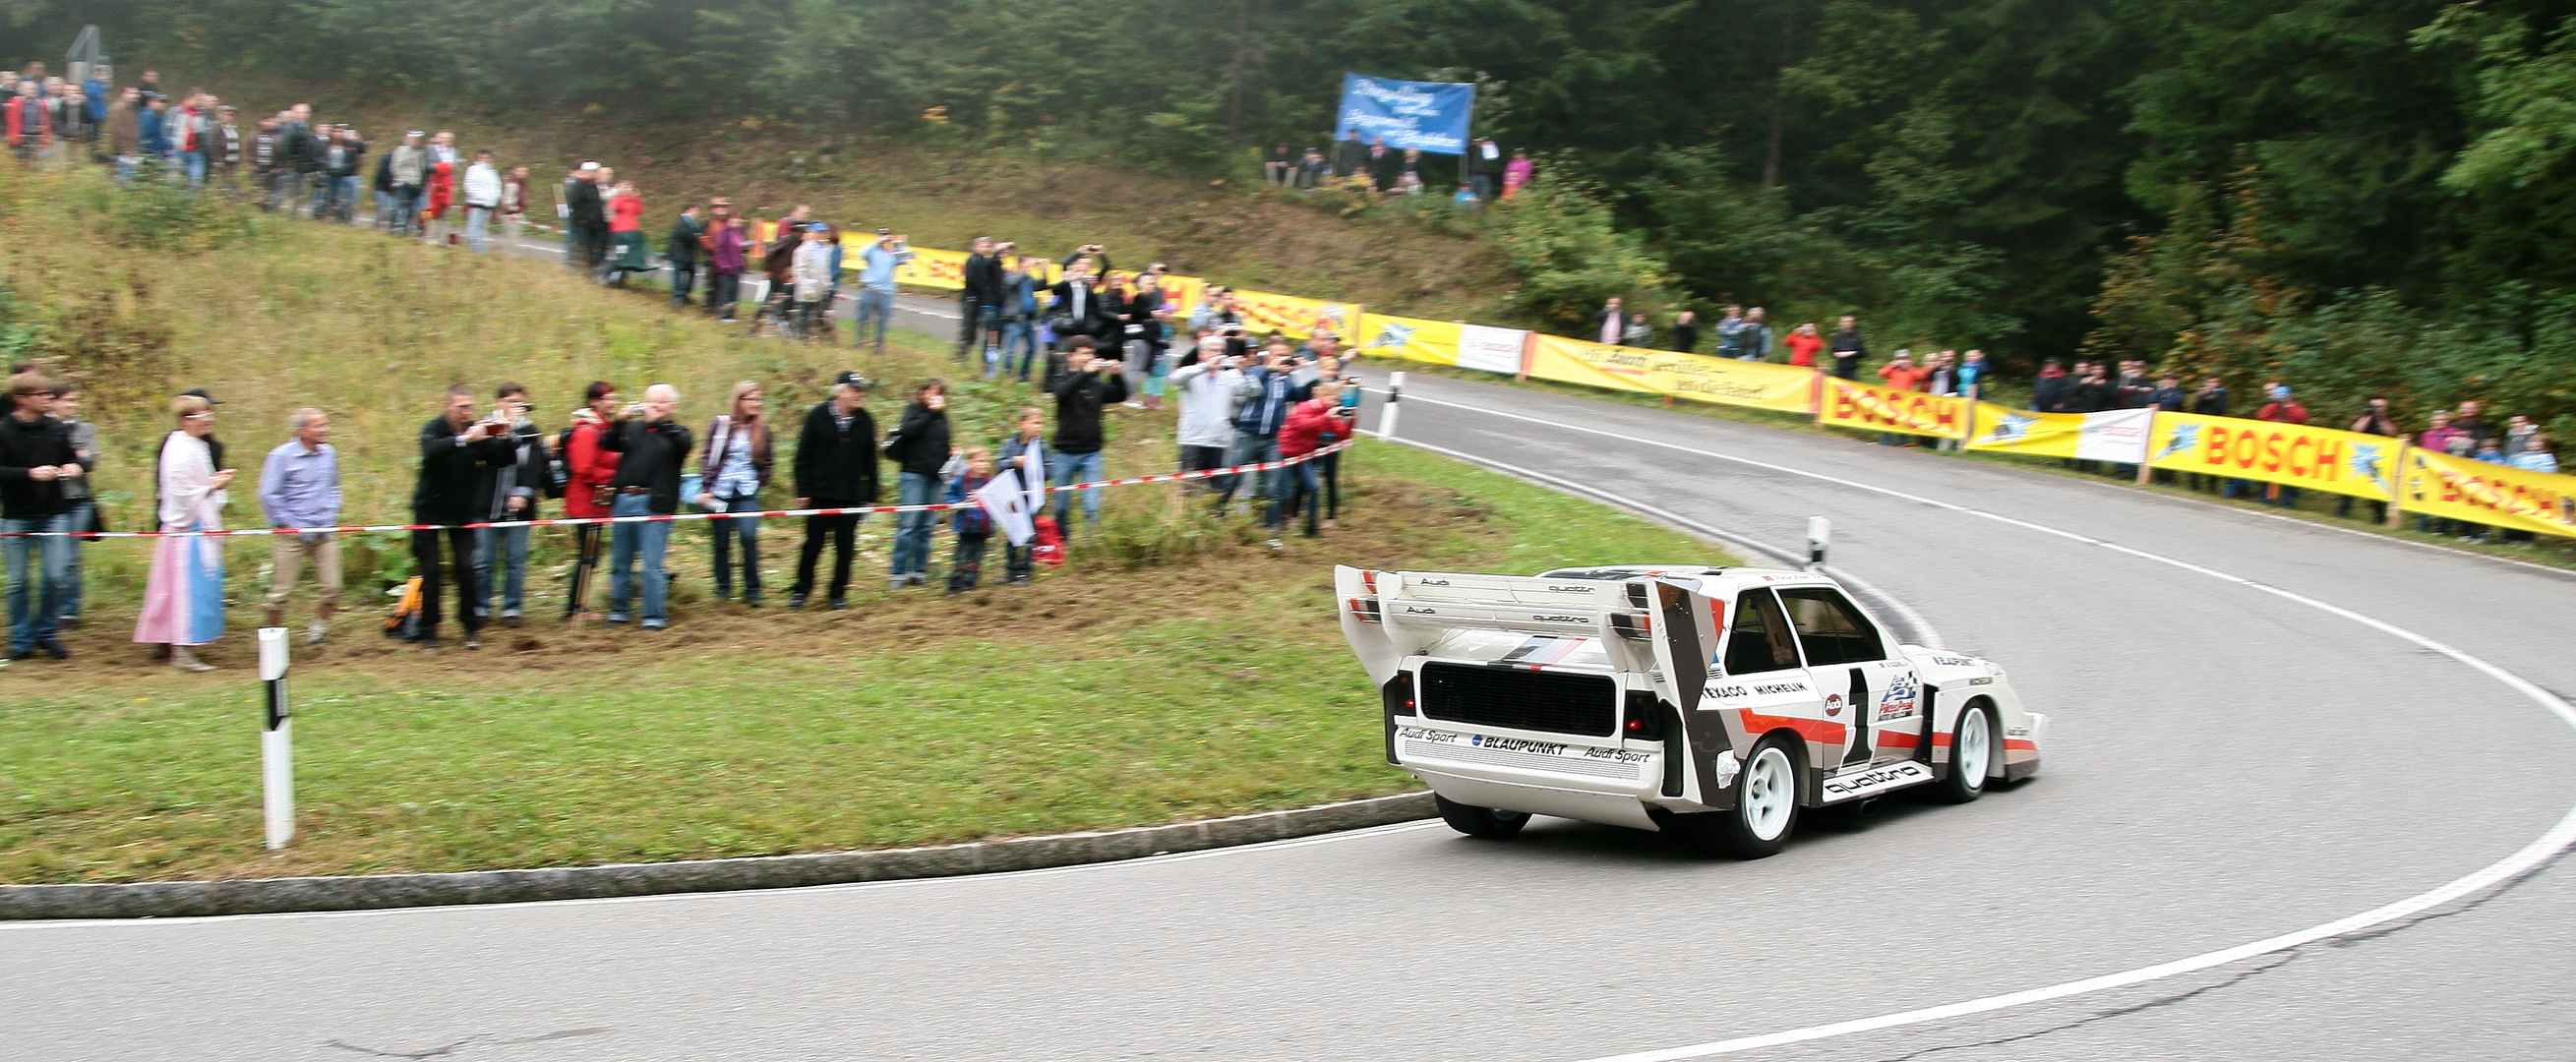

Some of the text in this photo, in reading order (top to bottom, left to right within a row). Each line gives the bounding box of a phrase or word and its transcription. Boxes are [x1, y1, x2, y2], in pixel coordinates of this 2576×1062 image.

[1836, 385, 1955, 433] BOSCH
[2204, 426, 2344, 481] BOSCH
[1548, 585, 1595, 595] quattr
[1532, 615, 1589, 623] quattro
[1702, 681, 1808, 699] TEXACO MICHELIN
[1826, 697, 1842, 711] Audi
[1841, 668, 1874, 767] 1
[1400, 728, 1458, 743] Audi Sport
[1483, 737, 1568, 756] BLAUPUNKT
[1585, 746, 1650, 764] Audi Sport
[1825, 766, 1921, 794] quattro
